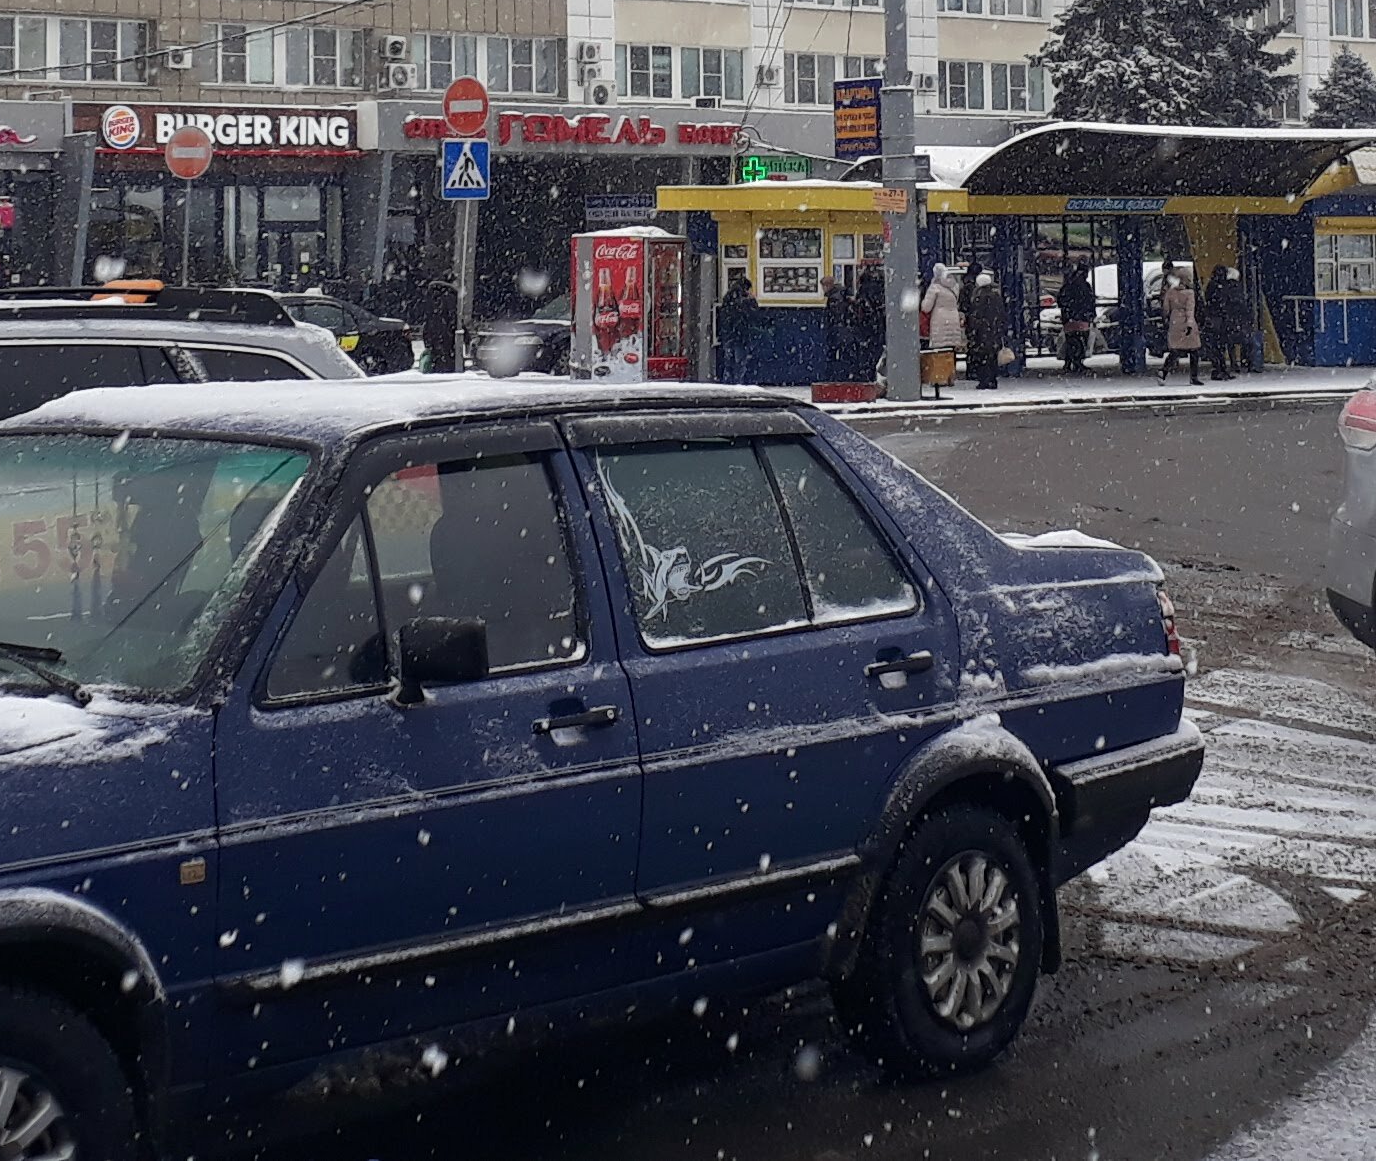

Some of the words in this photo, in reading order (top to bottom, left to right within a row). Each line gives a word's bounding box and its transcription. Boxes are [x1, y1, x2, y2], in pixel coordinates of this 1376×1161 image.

[108, 123, 135, 138] KING
[155, 113, 273, 145] BURGER
[279, 116, 350, 146] KING
[498, 113, 666, 146] ГОМЕЛЬ
